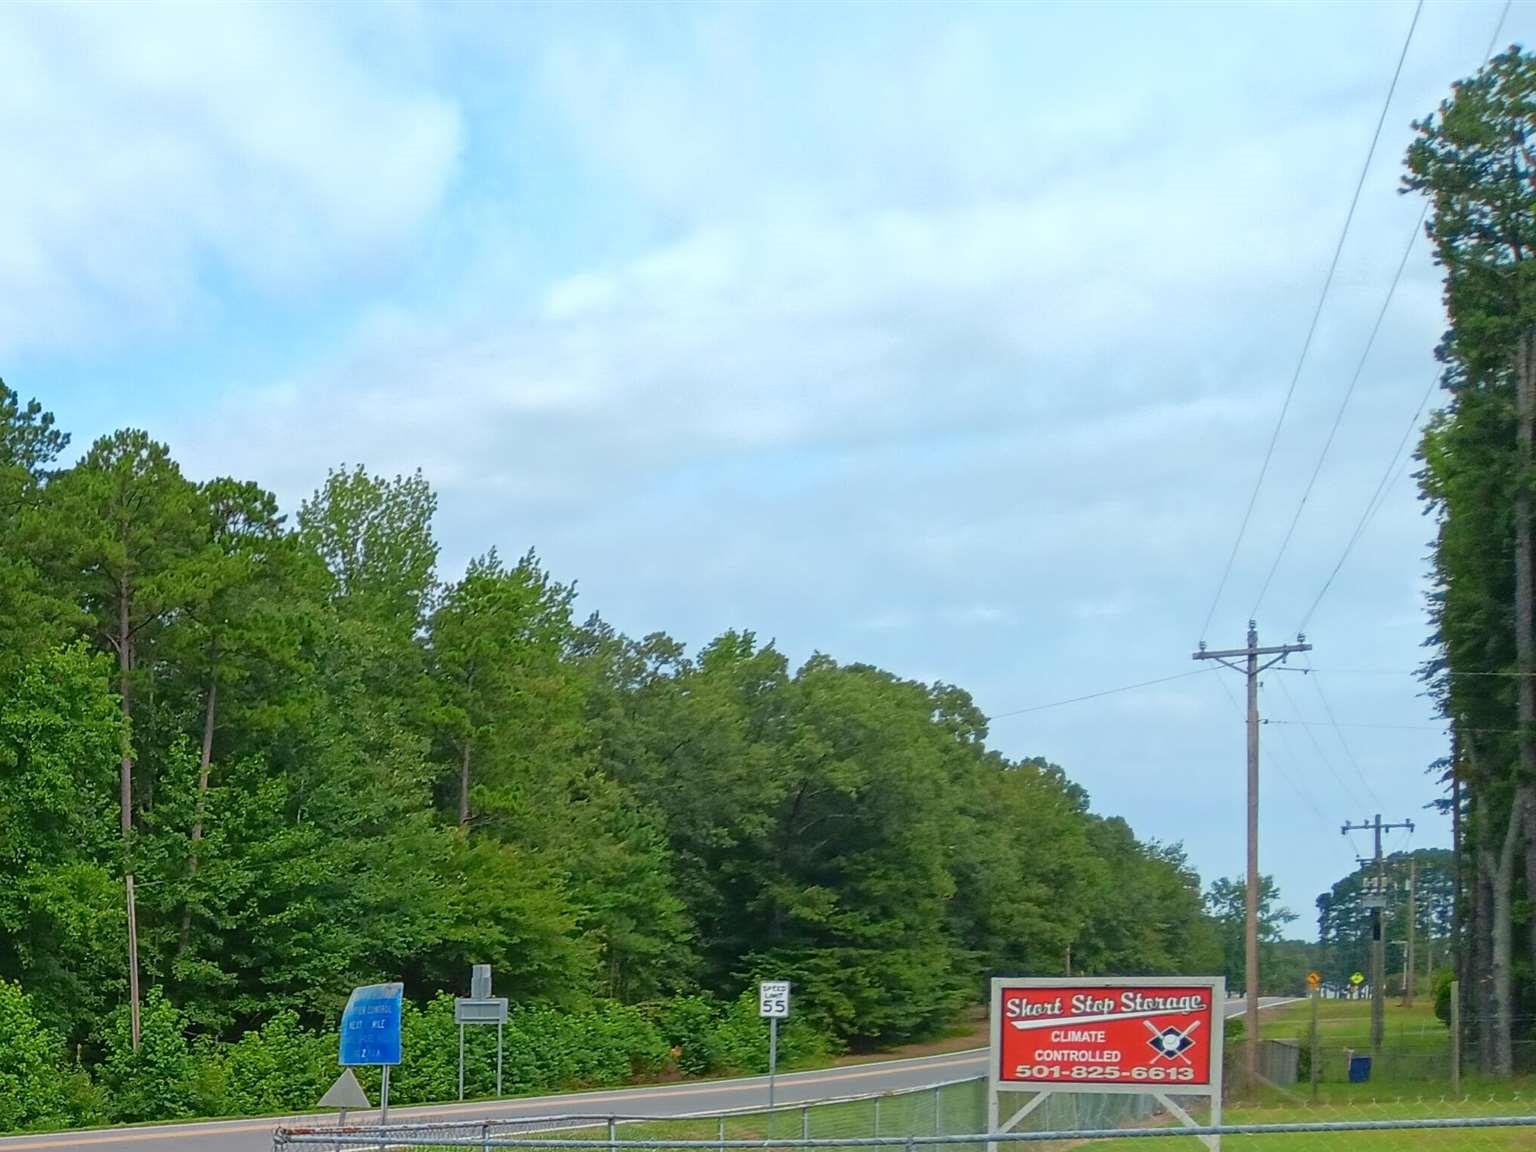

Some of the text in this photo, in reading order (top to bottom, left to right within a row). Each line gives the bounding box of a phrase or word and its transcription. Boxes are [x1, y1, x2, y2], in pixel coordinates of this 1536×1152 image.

[763, 1000, 785, 1012] 55
[1006, 991, 1203, 1018] Short Stop Storage
[1050, 1030, 1106, 1043] CLIMATE
[1034, 1049, 1122, 1062] CONTROLLED
[1015, 1065, 1195, 1080] 501-825-6613
